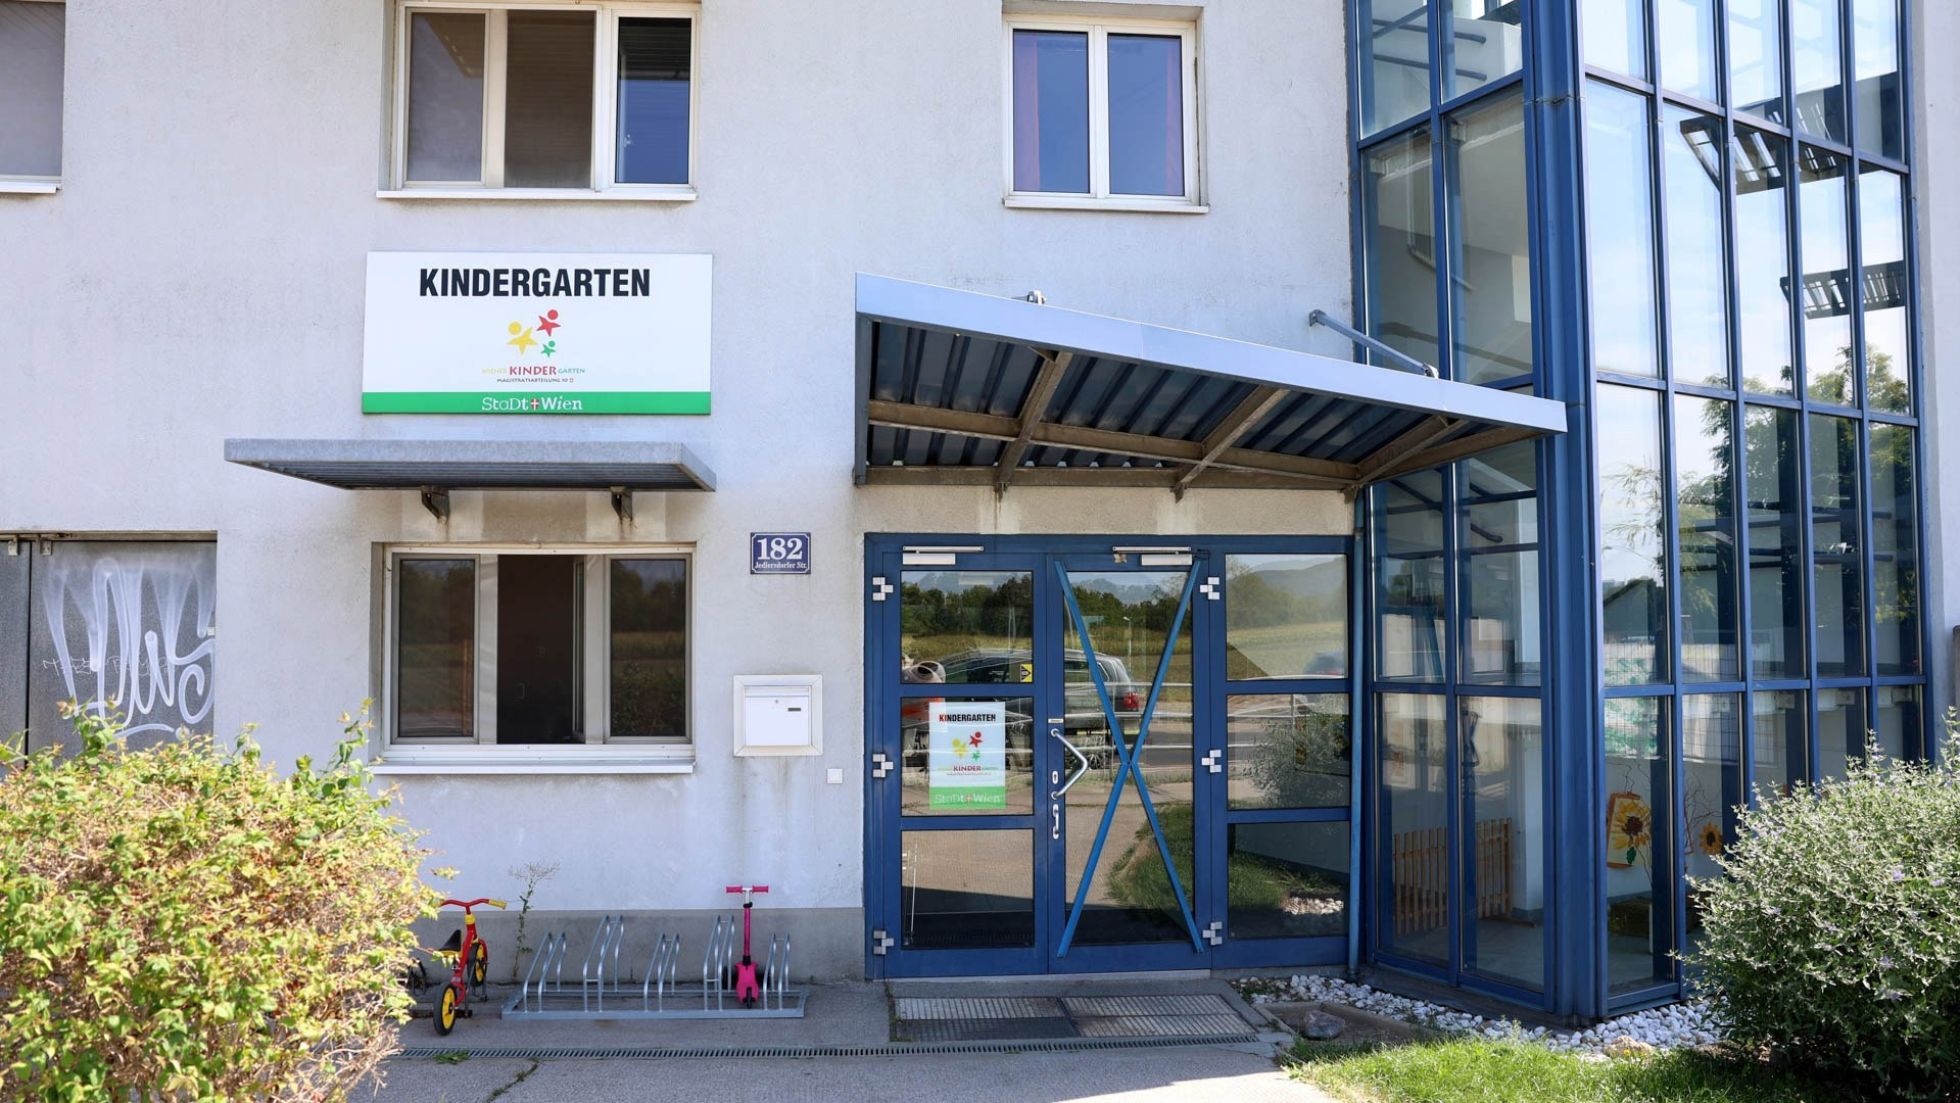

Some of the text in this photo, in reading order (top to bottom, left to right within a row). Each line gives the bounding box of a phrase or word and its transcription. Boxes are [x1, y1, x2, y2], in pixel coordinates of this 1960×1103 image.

[420, 268, 650, 297] KINDERGARTEN
[509, 366, 557, 376] KINDER
[541, 395, 583, 410] Wien
[757, 538, 802, 560] 182
[939, 714, 996, 722] KINDERGARTEN
